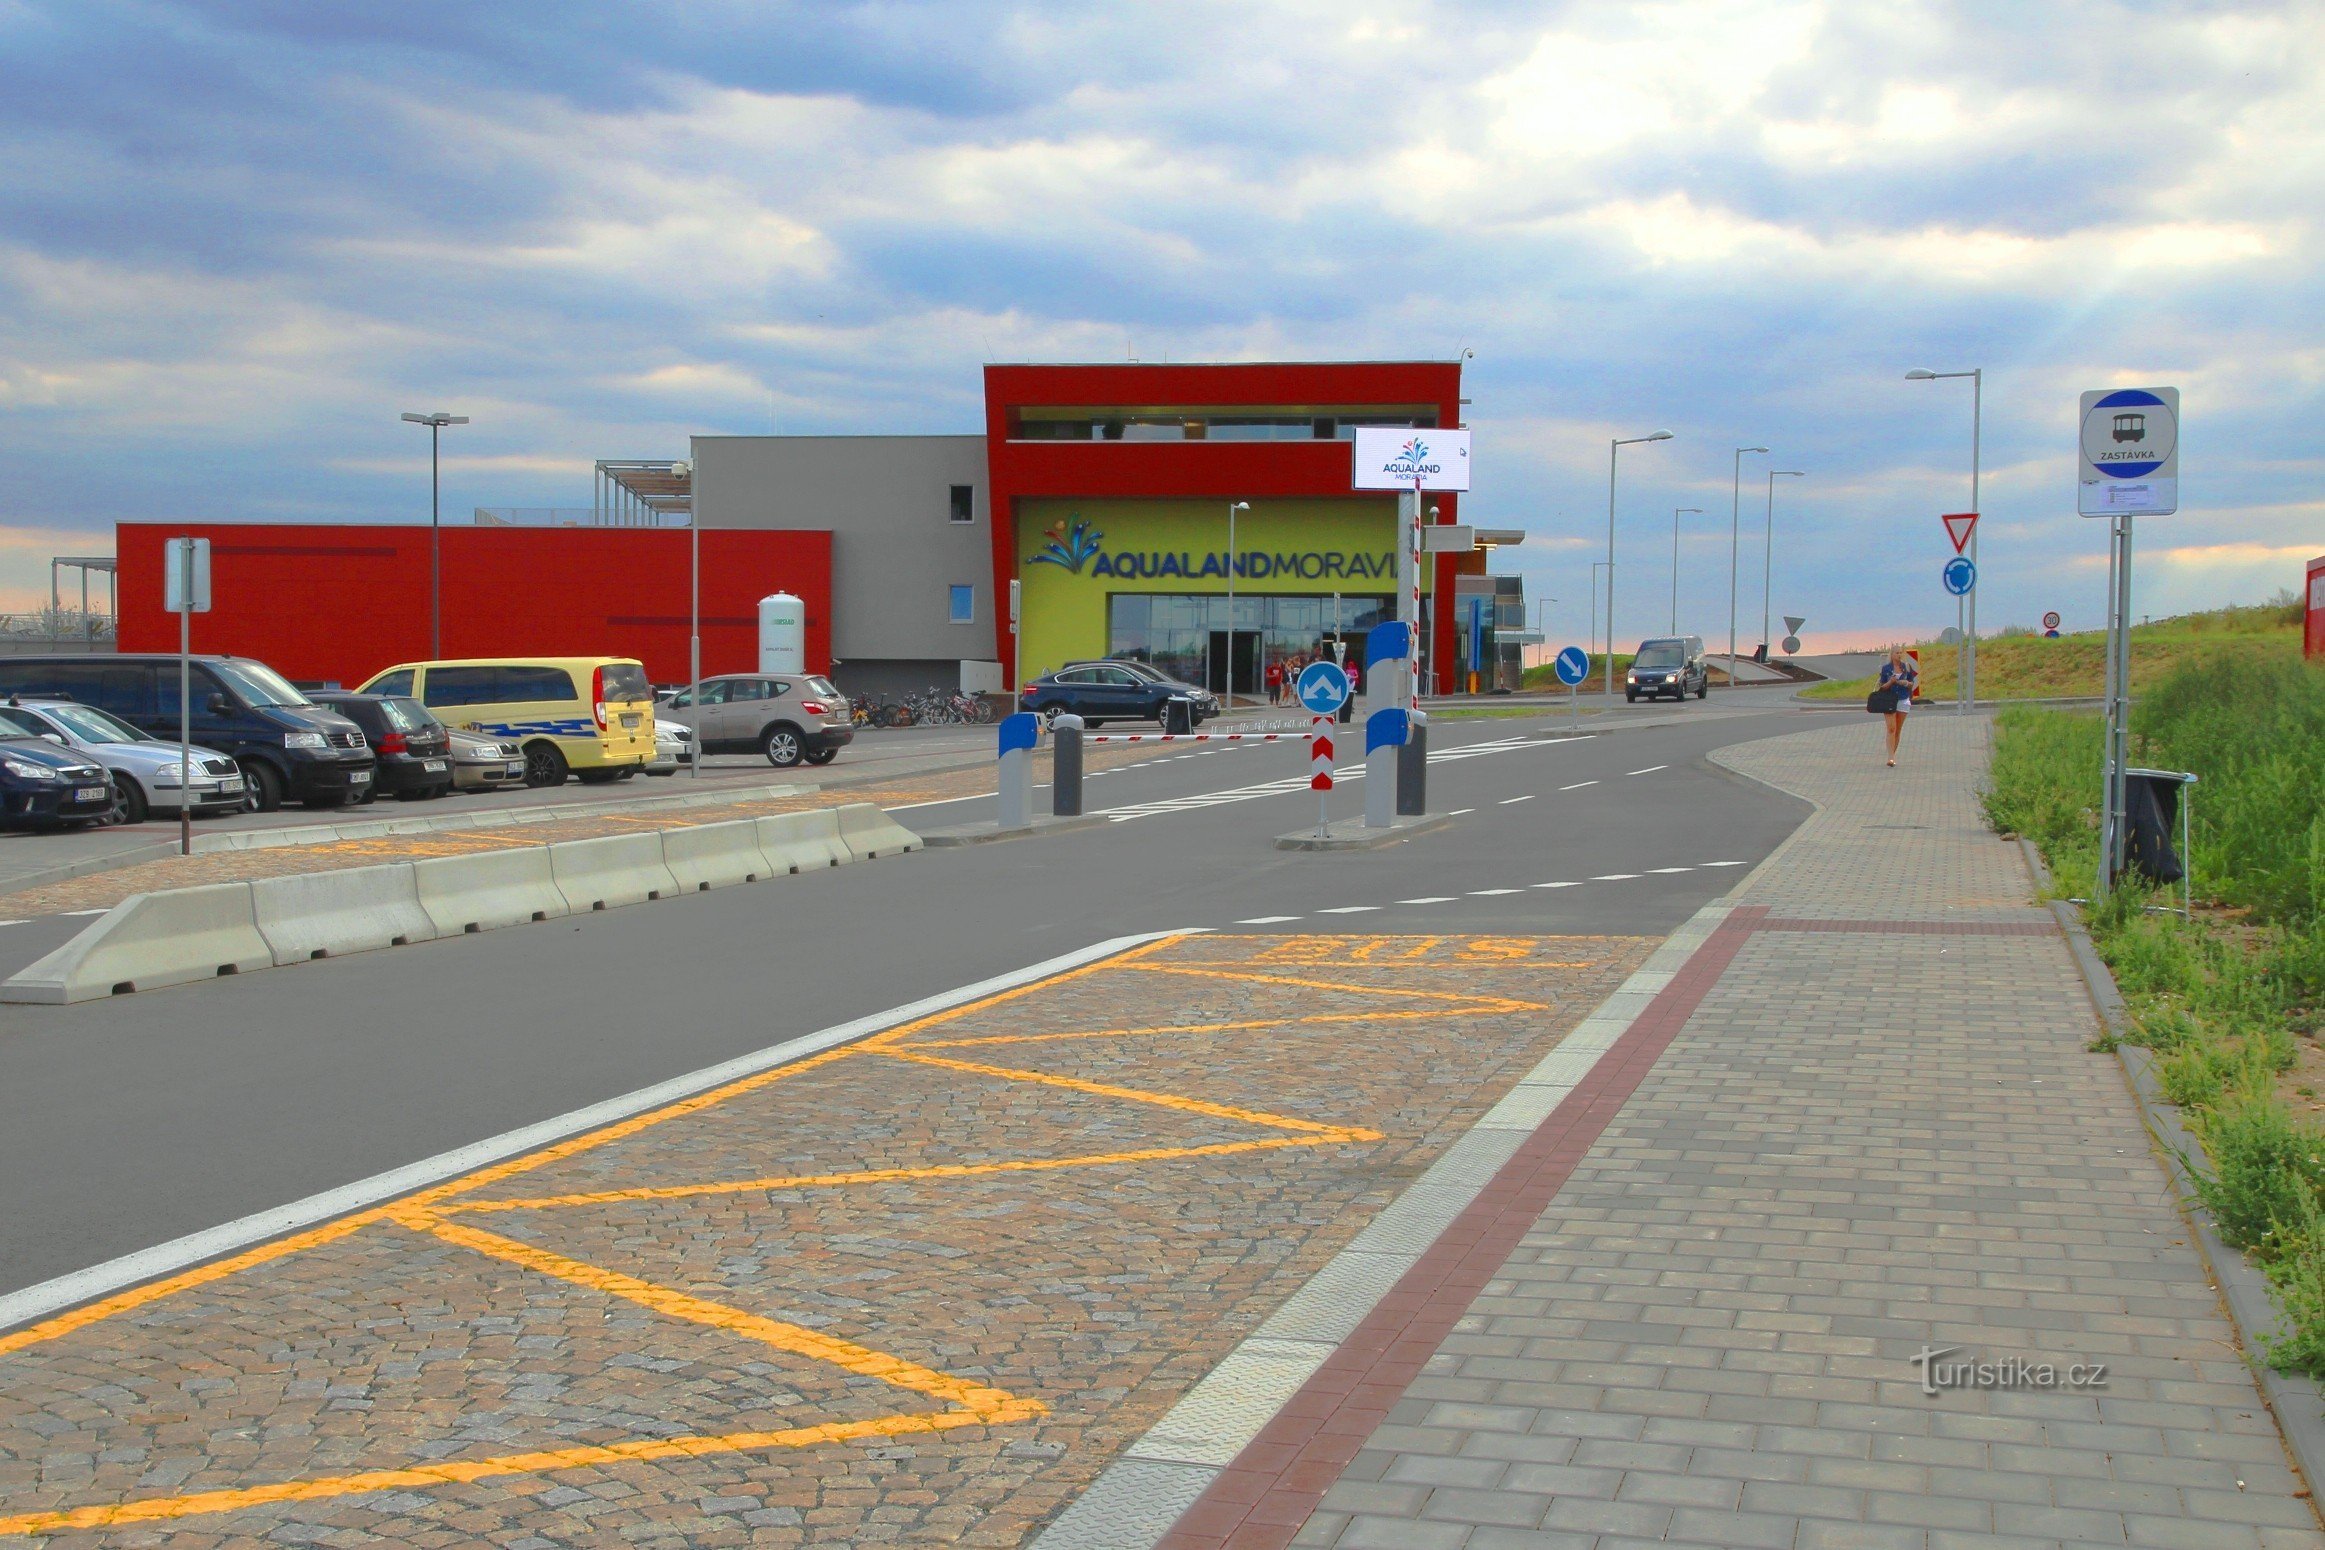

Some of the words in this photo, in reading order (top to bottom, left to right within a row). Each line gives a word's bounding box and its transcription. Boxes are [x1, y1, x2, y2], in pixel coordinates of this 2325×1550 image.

[2101, 449, 2155, 460] ZASTÁVKA
[1383, 464, 1441, 474] AQUALAND
[2047, 616, 2057, 625] 30
[1254, 938, 1538, 960] BUS
